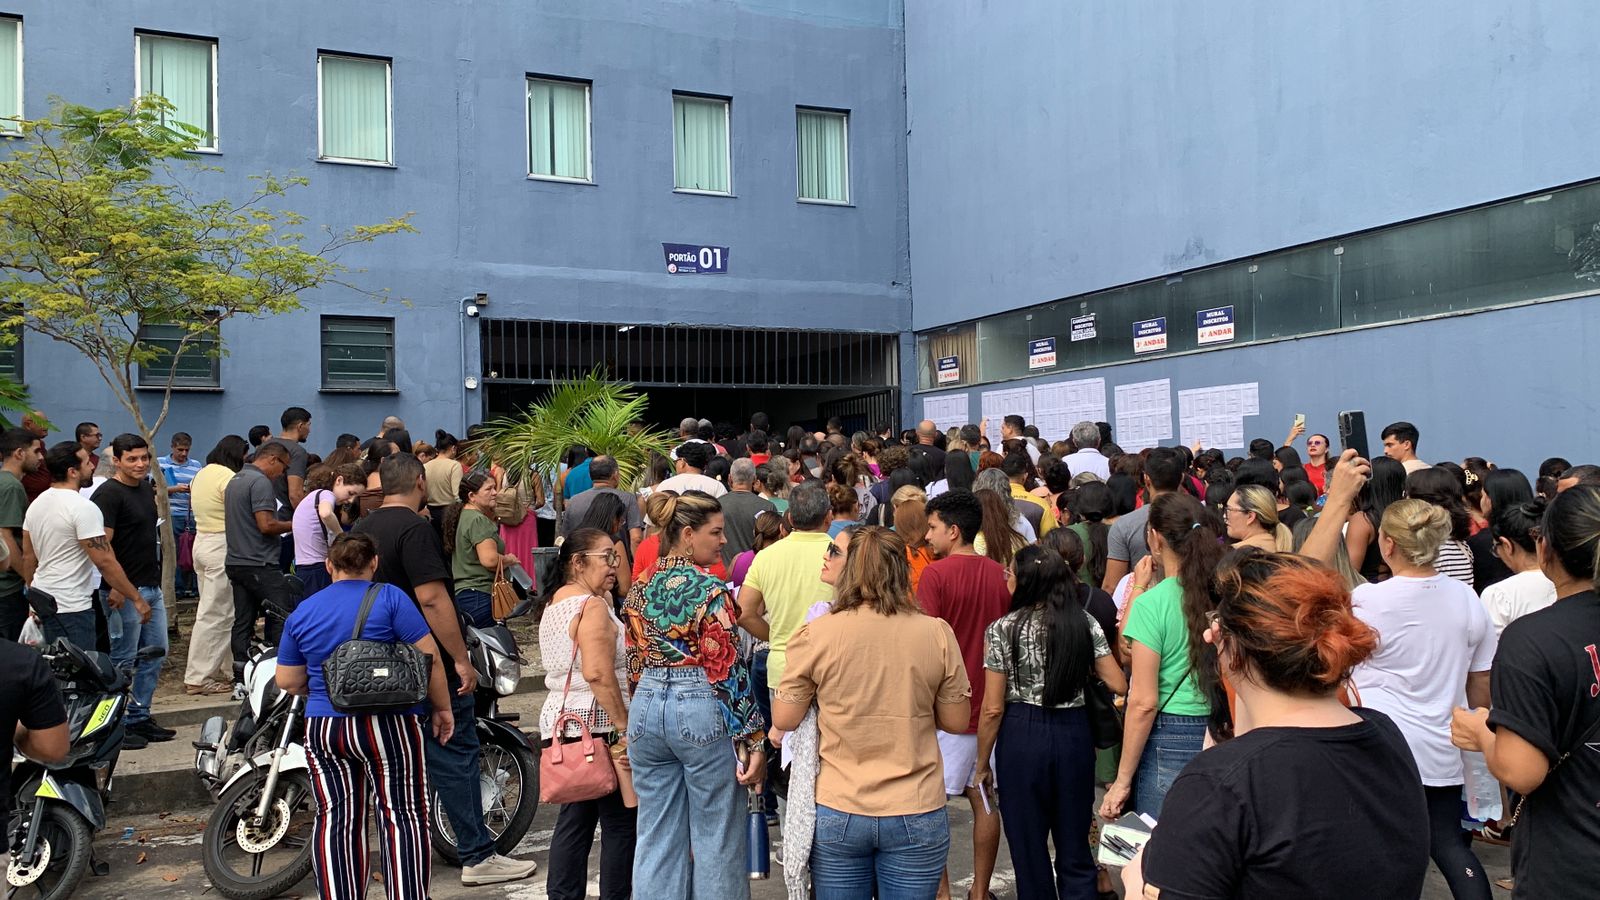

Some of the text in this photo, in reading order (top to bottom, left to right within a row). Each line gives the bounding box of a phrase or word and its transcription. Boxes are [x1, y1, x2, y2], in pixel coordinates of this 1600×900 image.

[669, 248, 721, 268] PORTÃO 01
[1203, 316, 1229, 325] INSCRITOS
[1138, 327, 1161, 335] INSCRITOS
[1208, 328, 1232, 337] ANDAR
[1144, 338, 1165, 346] ANDAR
[1037, 356, 1054, 364] ANDAR
[98, 704, 110, 722] NEO
